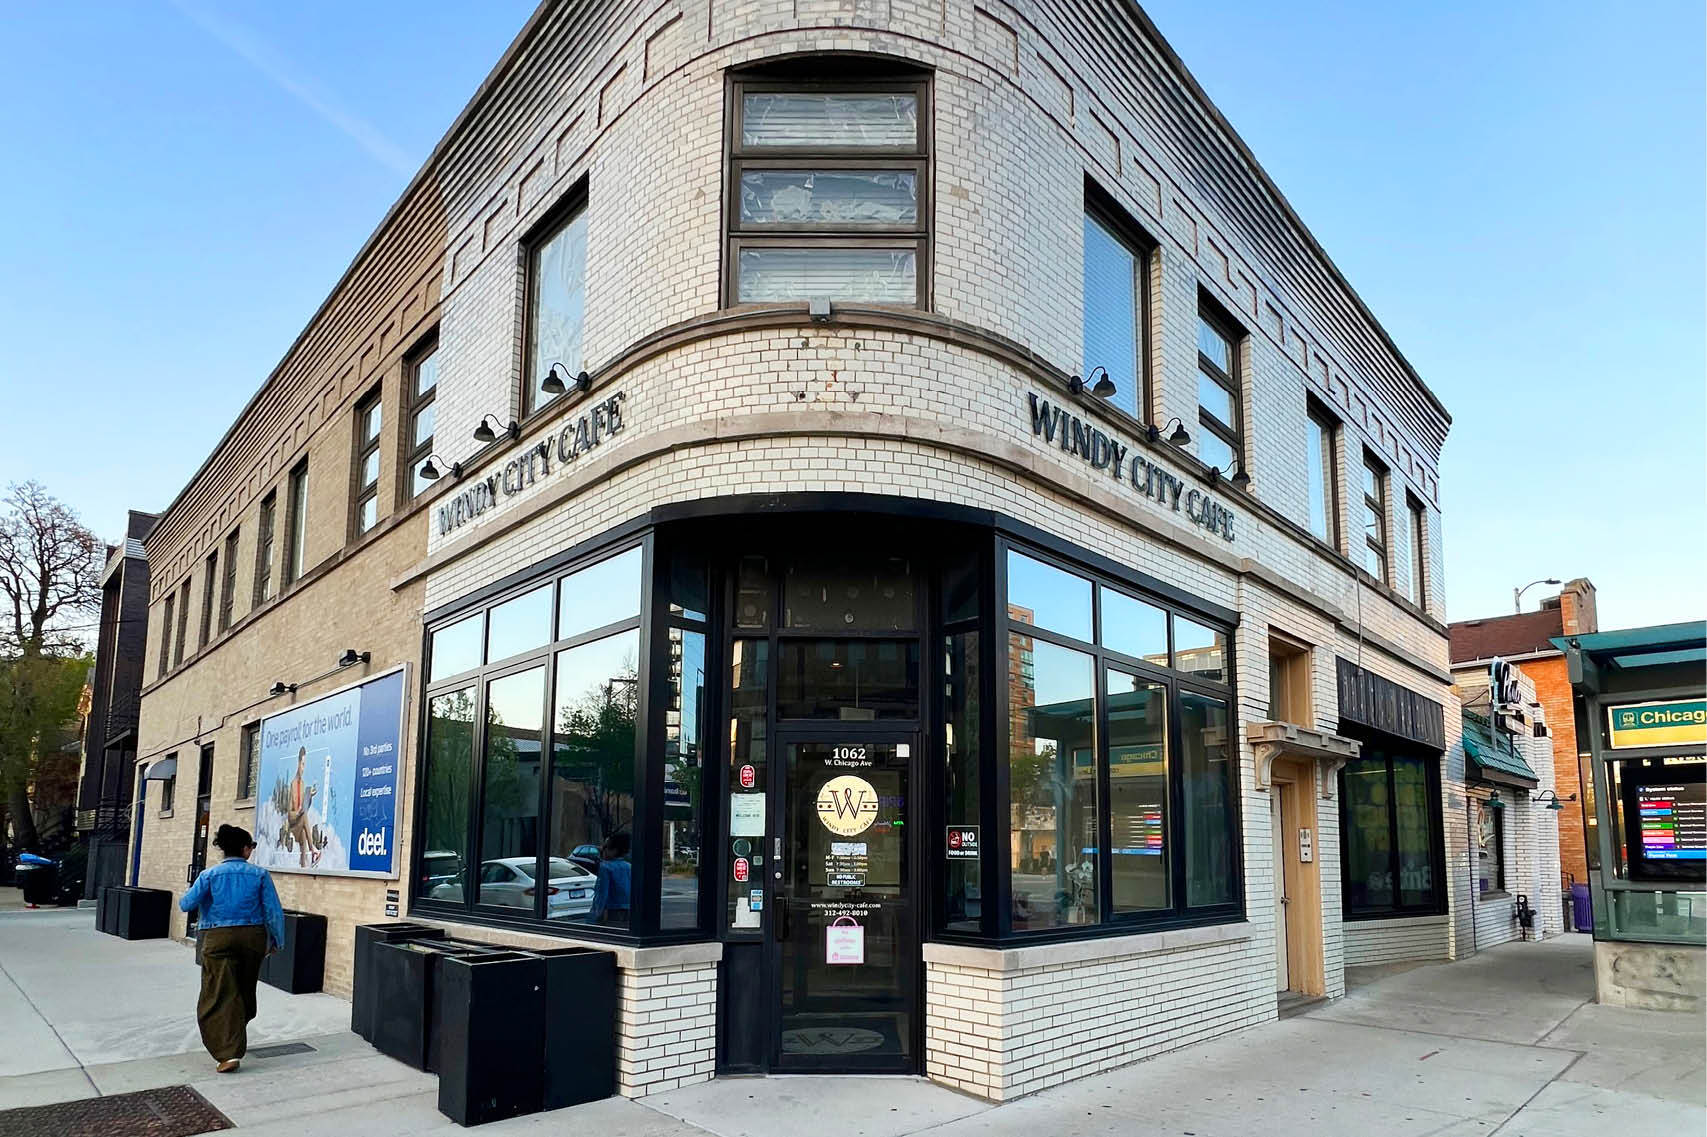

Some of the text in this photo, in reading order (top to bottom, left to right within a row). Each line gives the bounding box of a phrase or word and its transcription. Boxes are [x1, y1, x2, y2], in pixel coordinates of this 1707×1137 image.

[438, 390, 626, 536] WINDY CITY CAFE
[1028, 392, 1236, 543] WINDY CITY CAFE
[1640, 709, 1706, 724] Chicag
[266, 730, 280, 748] One
[280, 721, 302, 748] payroll
[302, 719, 313, 738] for
[313, 713, 327, 736] the
[832, 747, 866, 760] 1062
[833, 759, 859, 768] Chicago
[860, 759, 873, 767] Ave
[961, 831, 975, 842] NO
